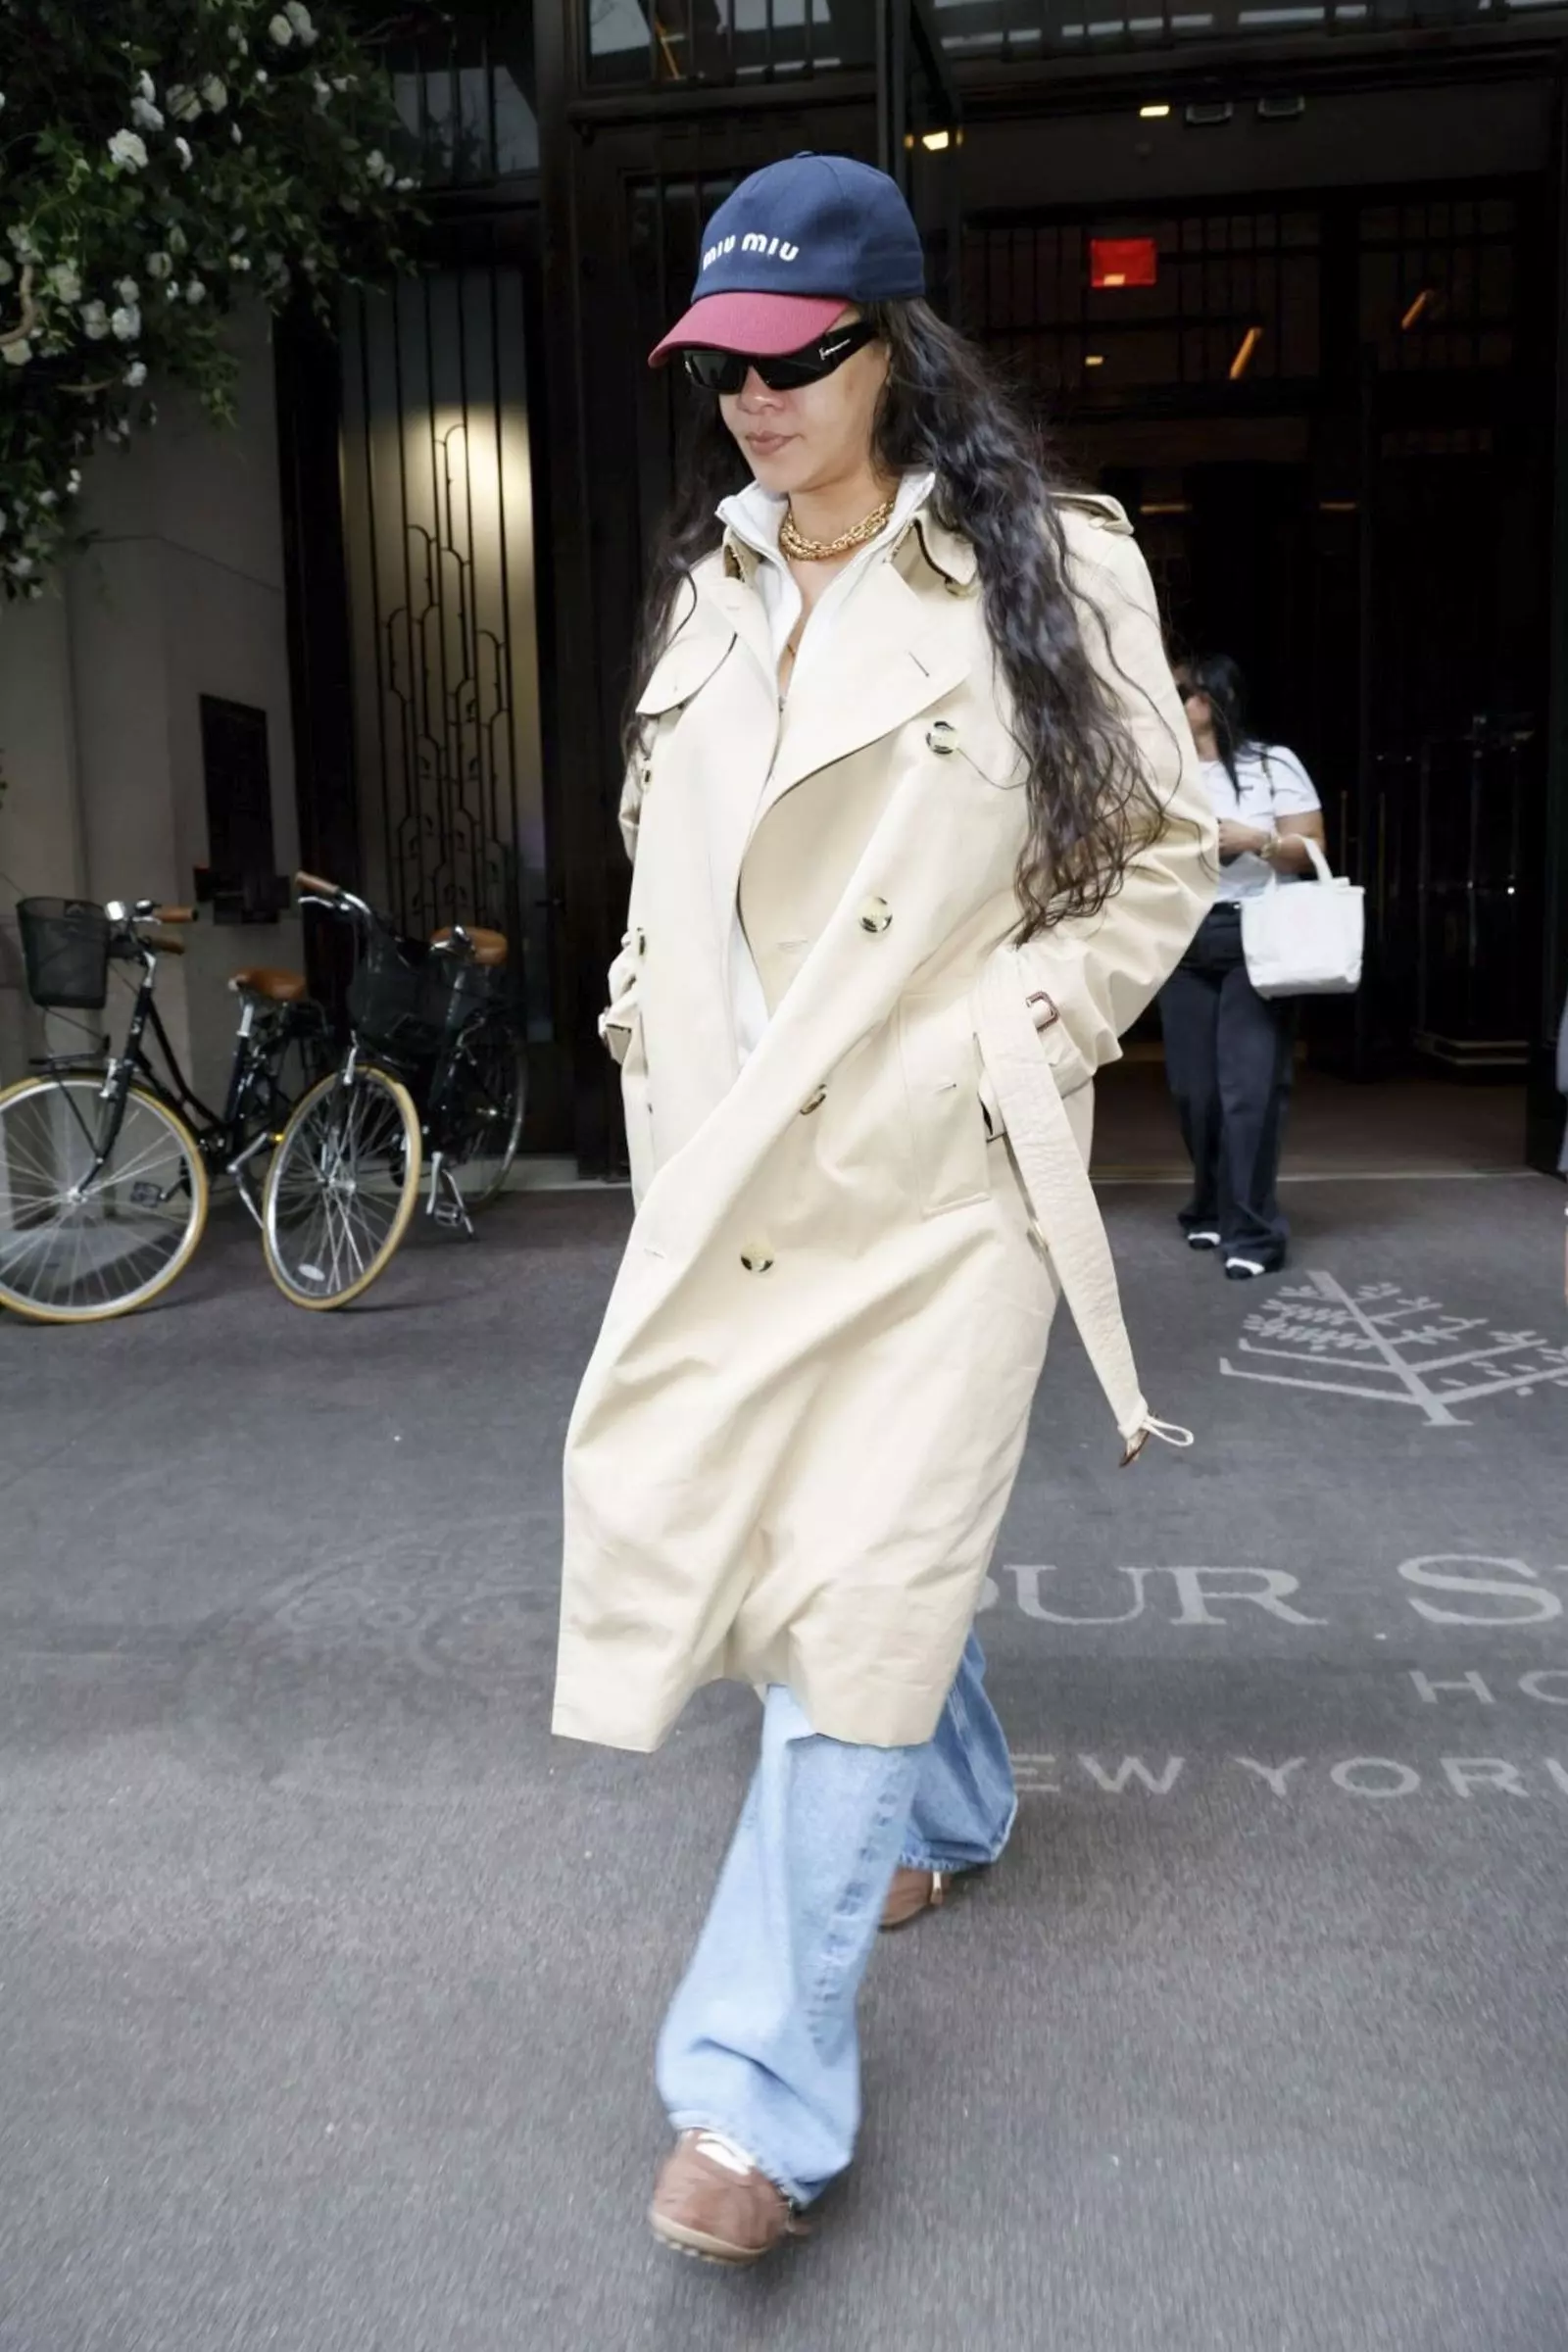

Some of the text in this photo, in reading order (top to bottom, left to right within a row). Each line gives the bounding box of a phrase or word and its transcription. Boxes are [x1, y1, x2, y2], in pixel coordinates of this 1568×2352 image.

[978, 1553, 1568, 1625] UR S
[1009, 1753, 1568, 1798] EW YOR
